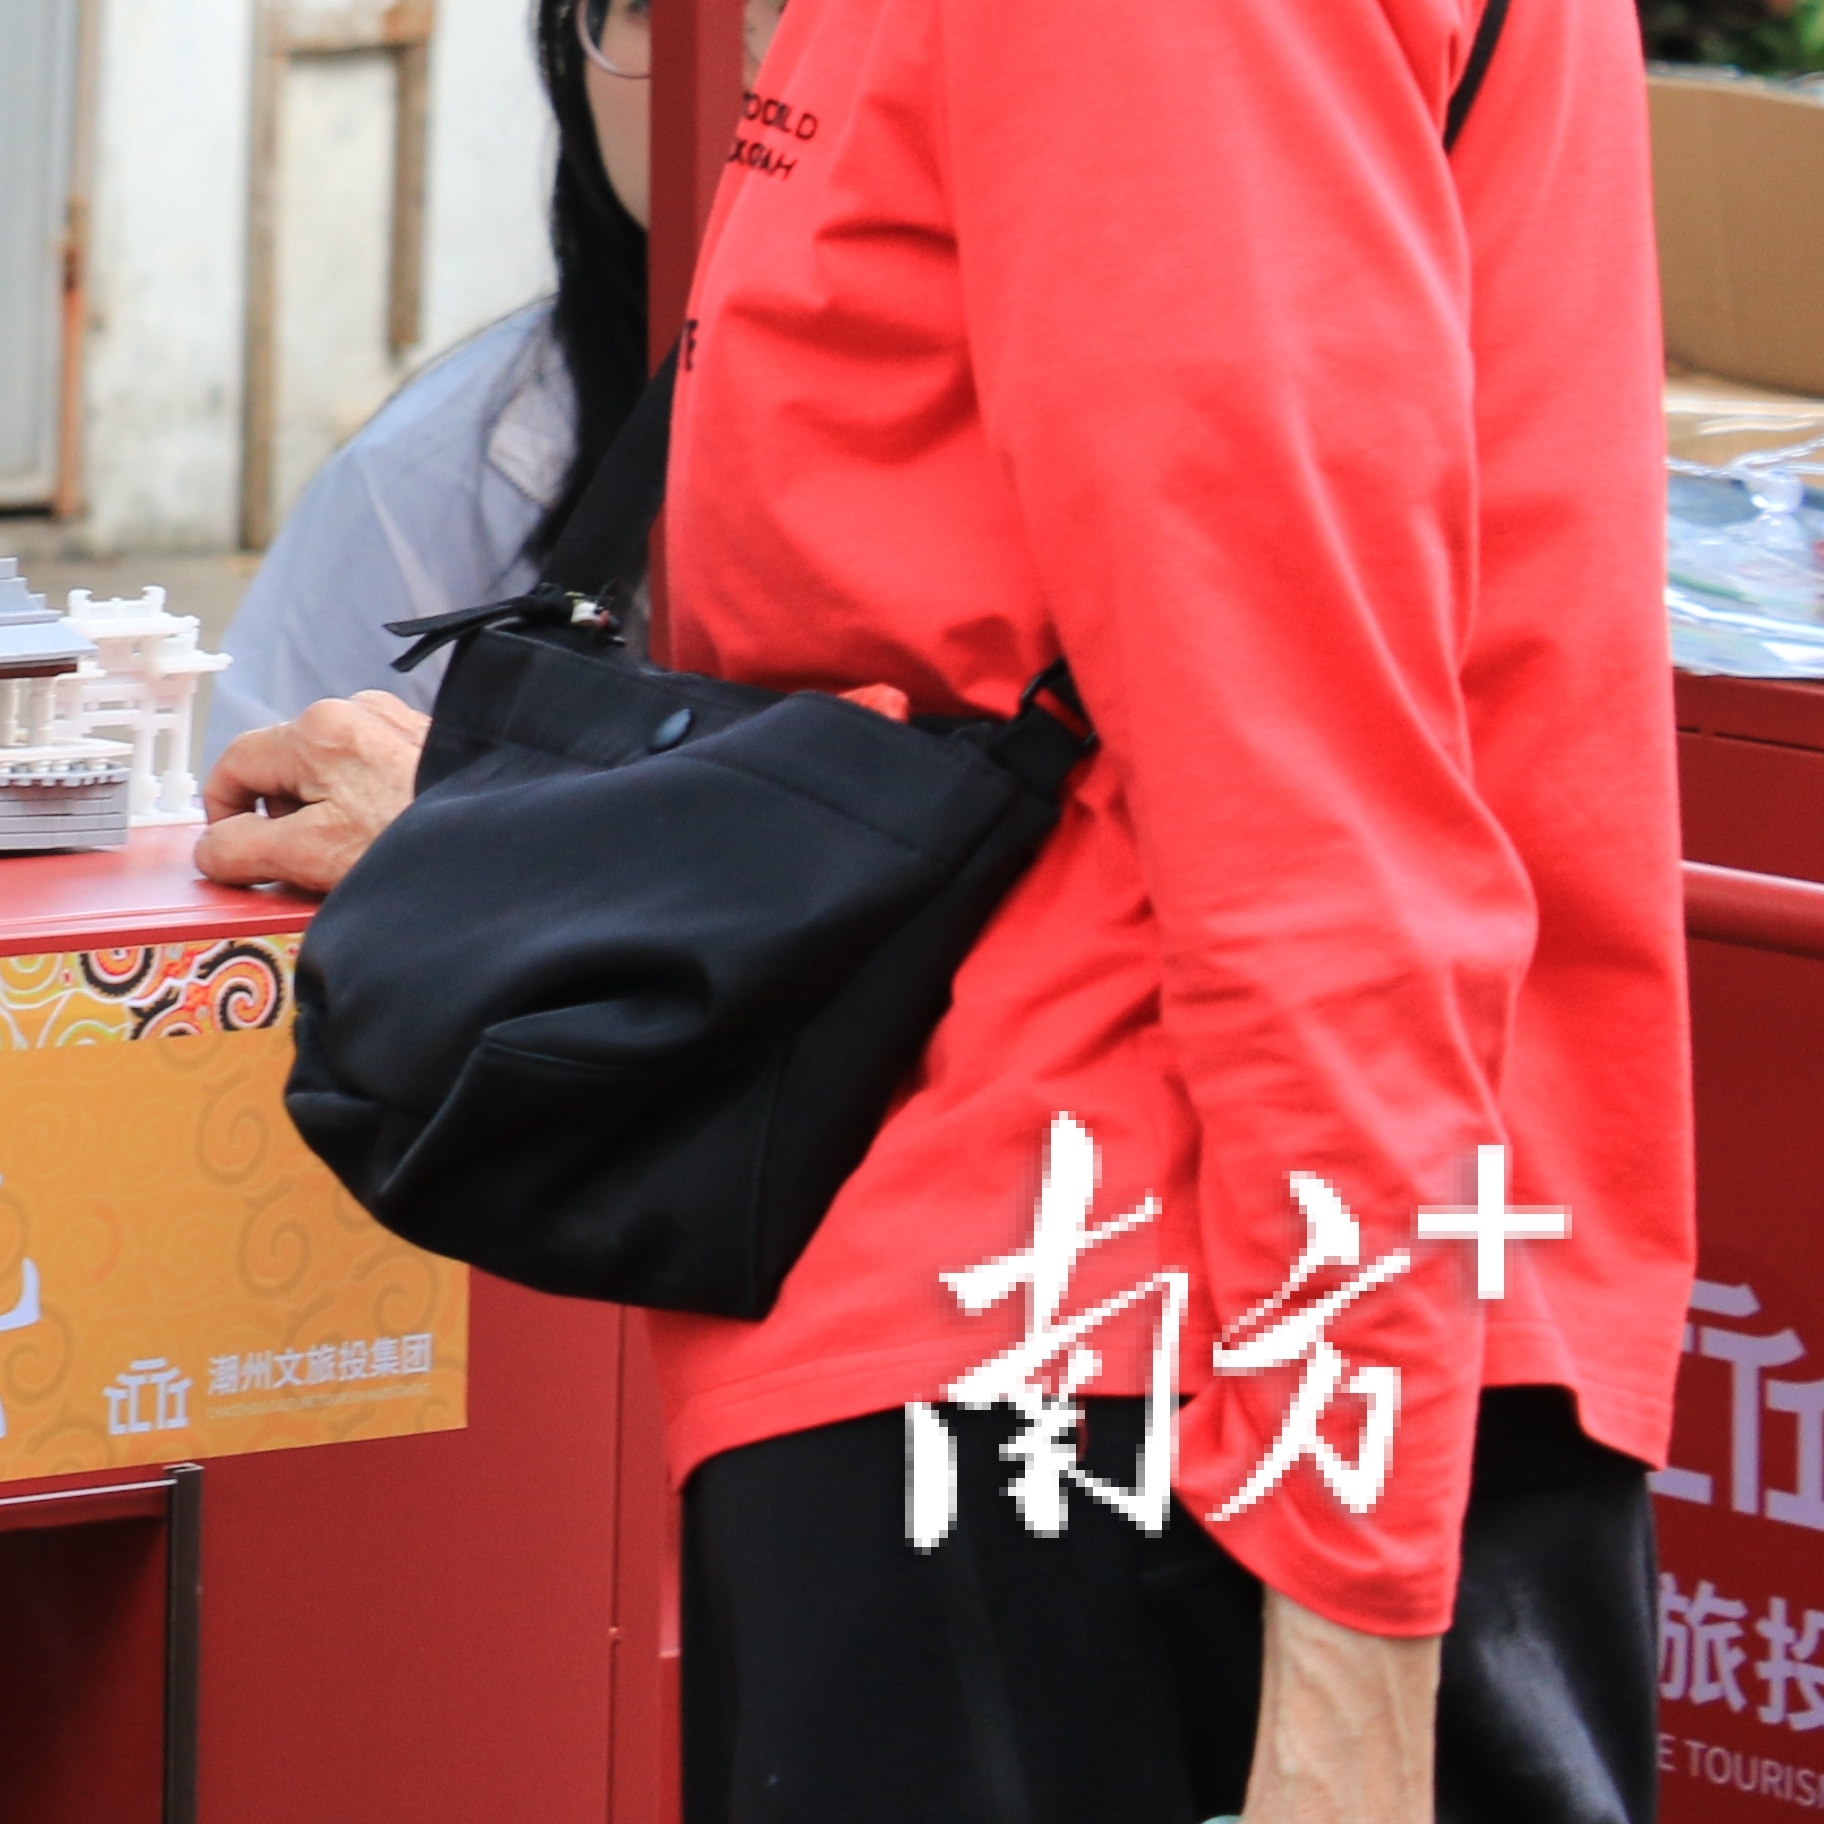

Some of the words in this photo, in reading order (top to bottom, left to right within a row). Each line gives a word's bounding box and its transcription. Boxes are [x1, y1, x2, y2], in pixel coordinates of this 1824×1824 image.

[207, 1332, 433, 1396] 潮州文旅投集团
[1684, 1738, 1824, 1810] TOURIS
